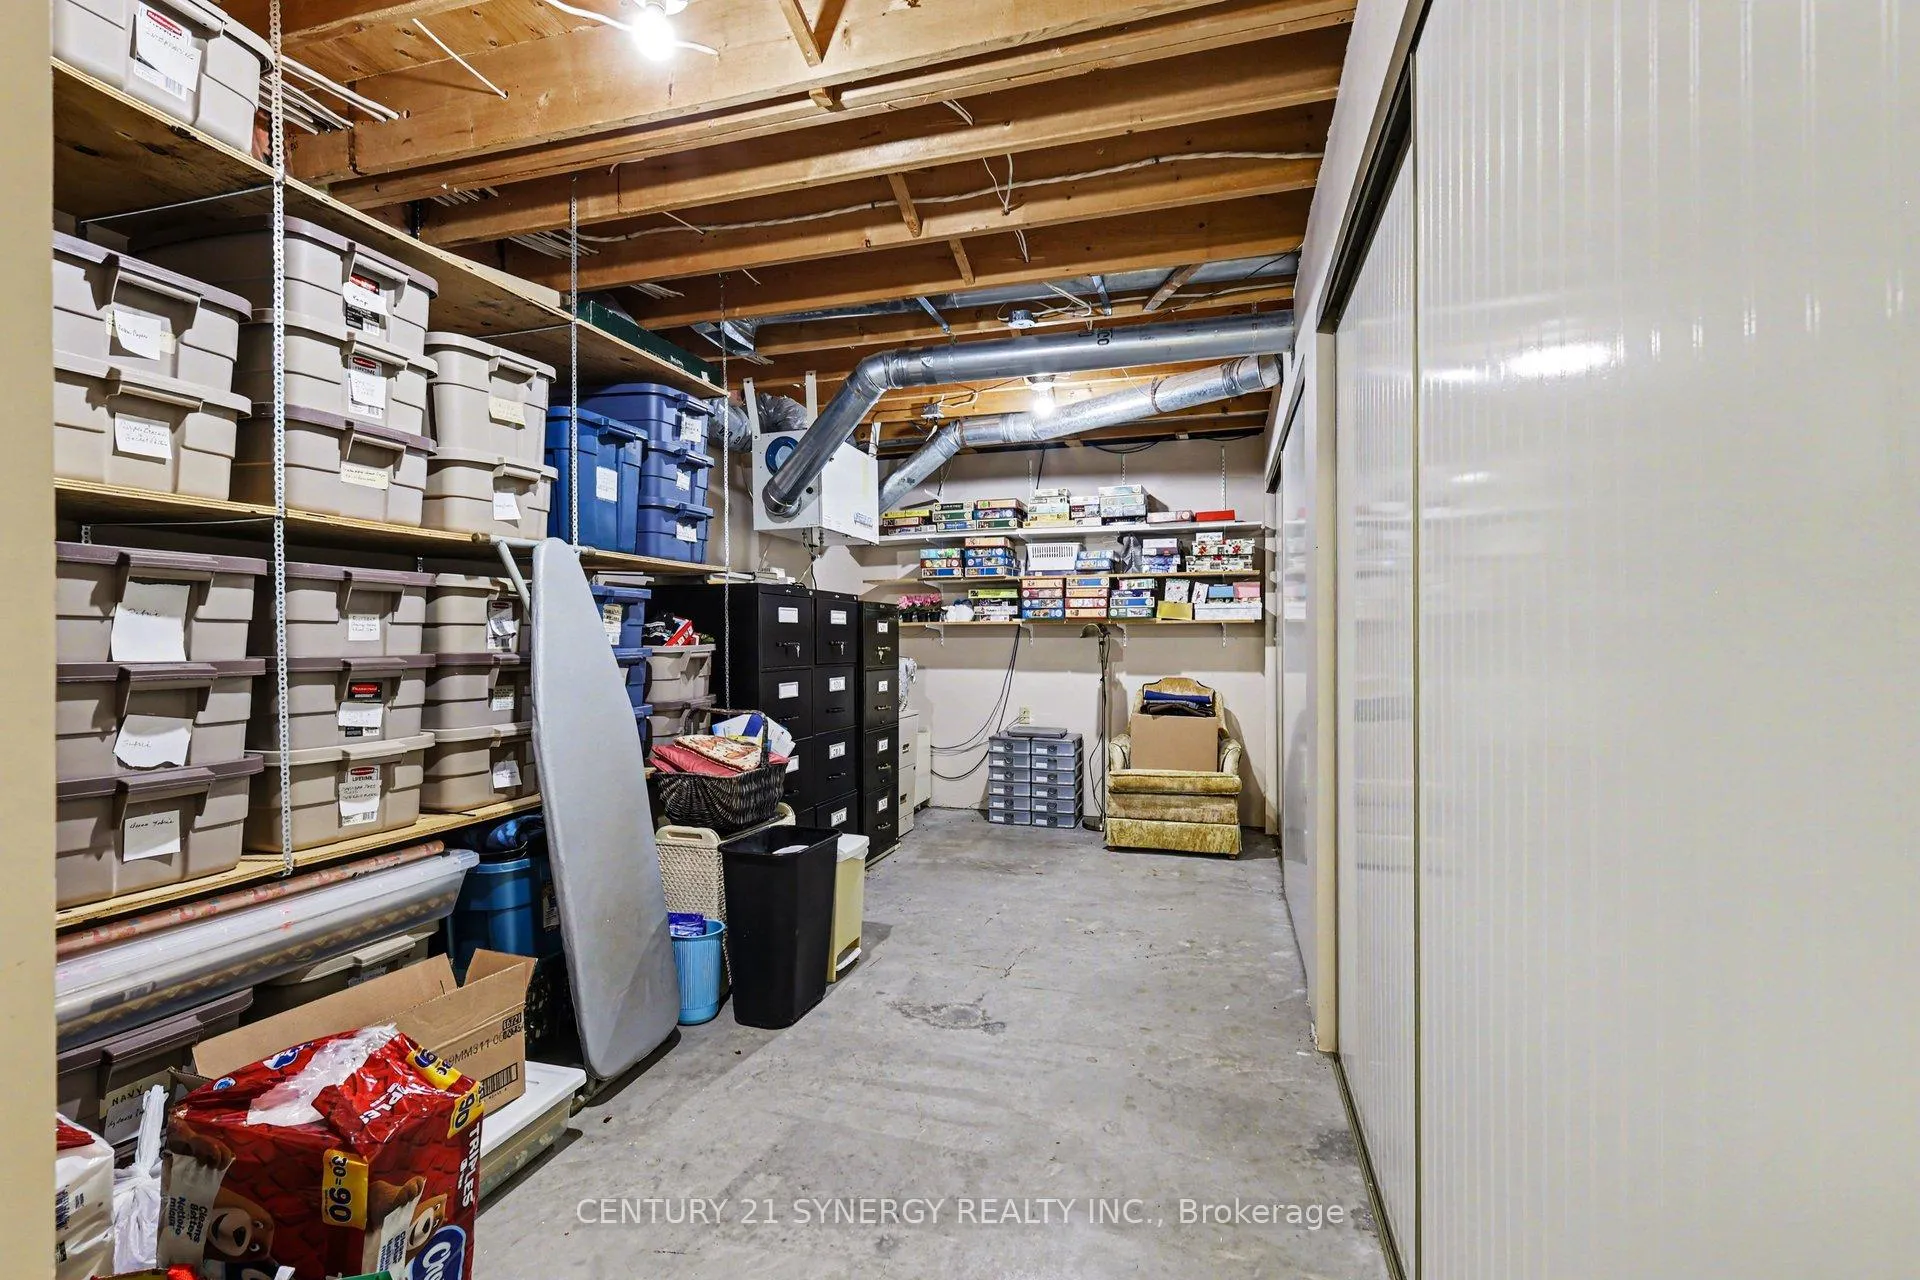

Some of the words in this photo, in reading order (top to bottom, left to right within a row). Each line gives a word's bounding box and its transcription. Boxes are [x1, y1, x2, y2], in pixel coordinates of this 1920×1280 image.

[112, 1084, 143, 1106] NAVY
[462, 1120, 481, 1208] TRIPLES
[186, 1203, 199, 1240] Better
[194, 1206, 208, 1243] Cleans
